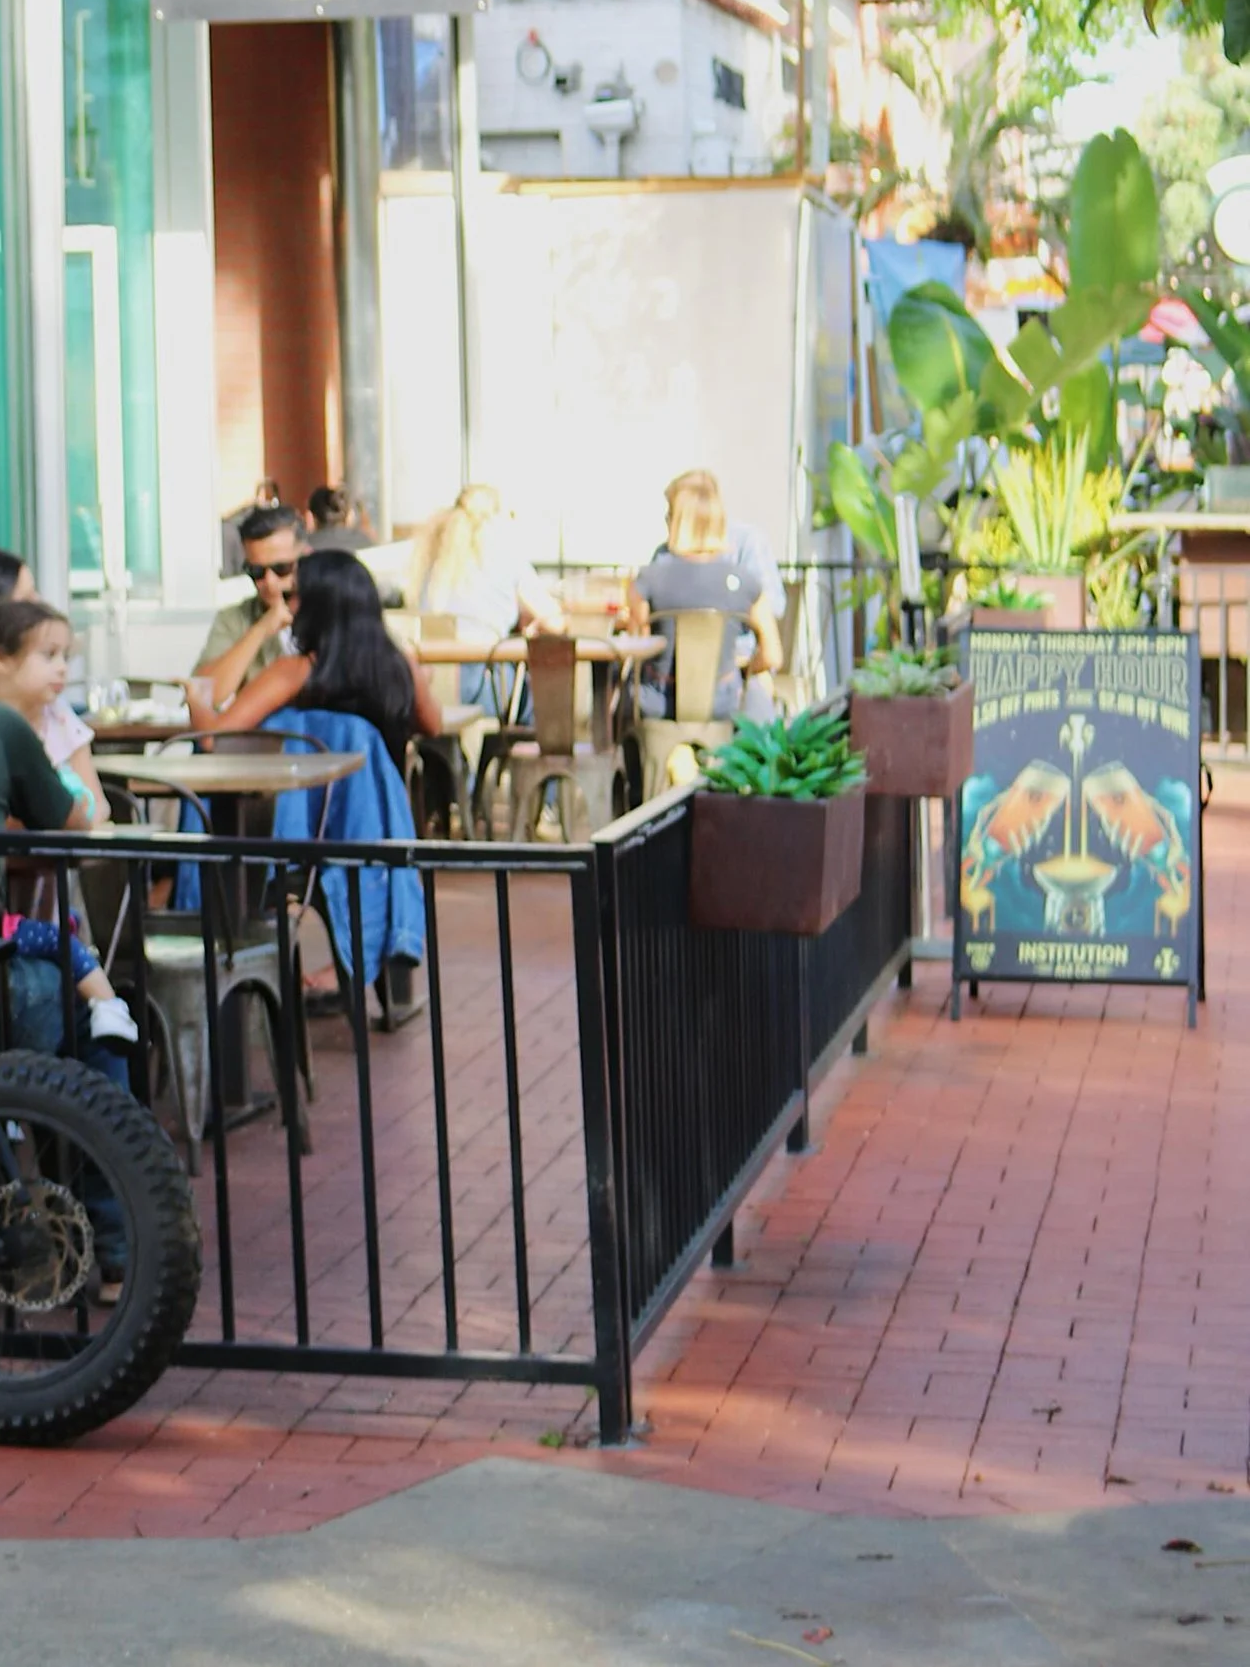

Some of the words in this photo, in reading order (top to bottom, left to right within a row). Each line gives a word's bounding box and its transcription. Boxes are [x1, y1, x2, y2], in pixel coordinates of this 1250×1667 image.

[970, 653, 1086, 700] HAPPY
[1094, 655, 1189, 708] HOUR
[1018, 941, 1129, 968] INSTITUTION
